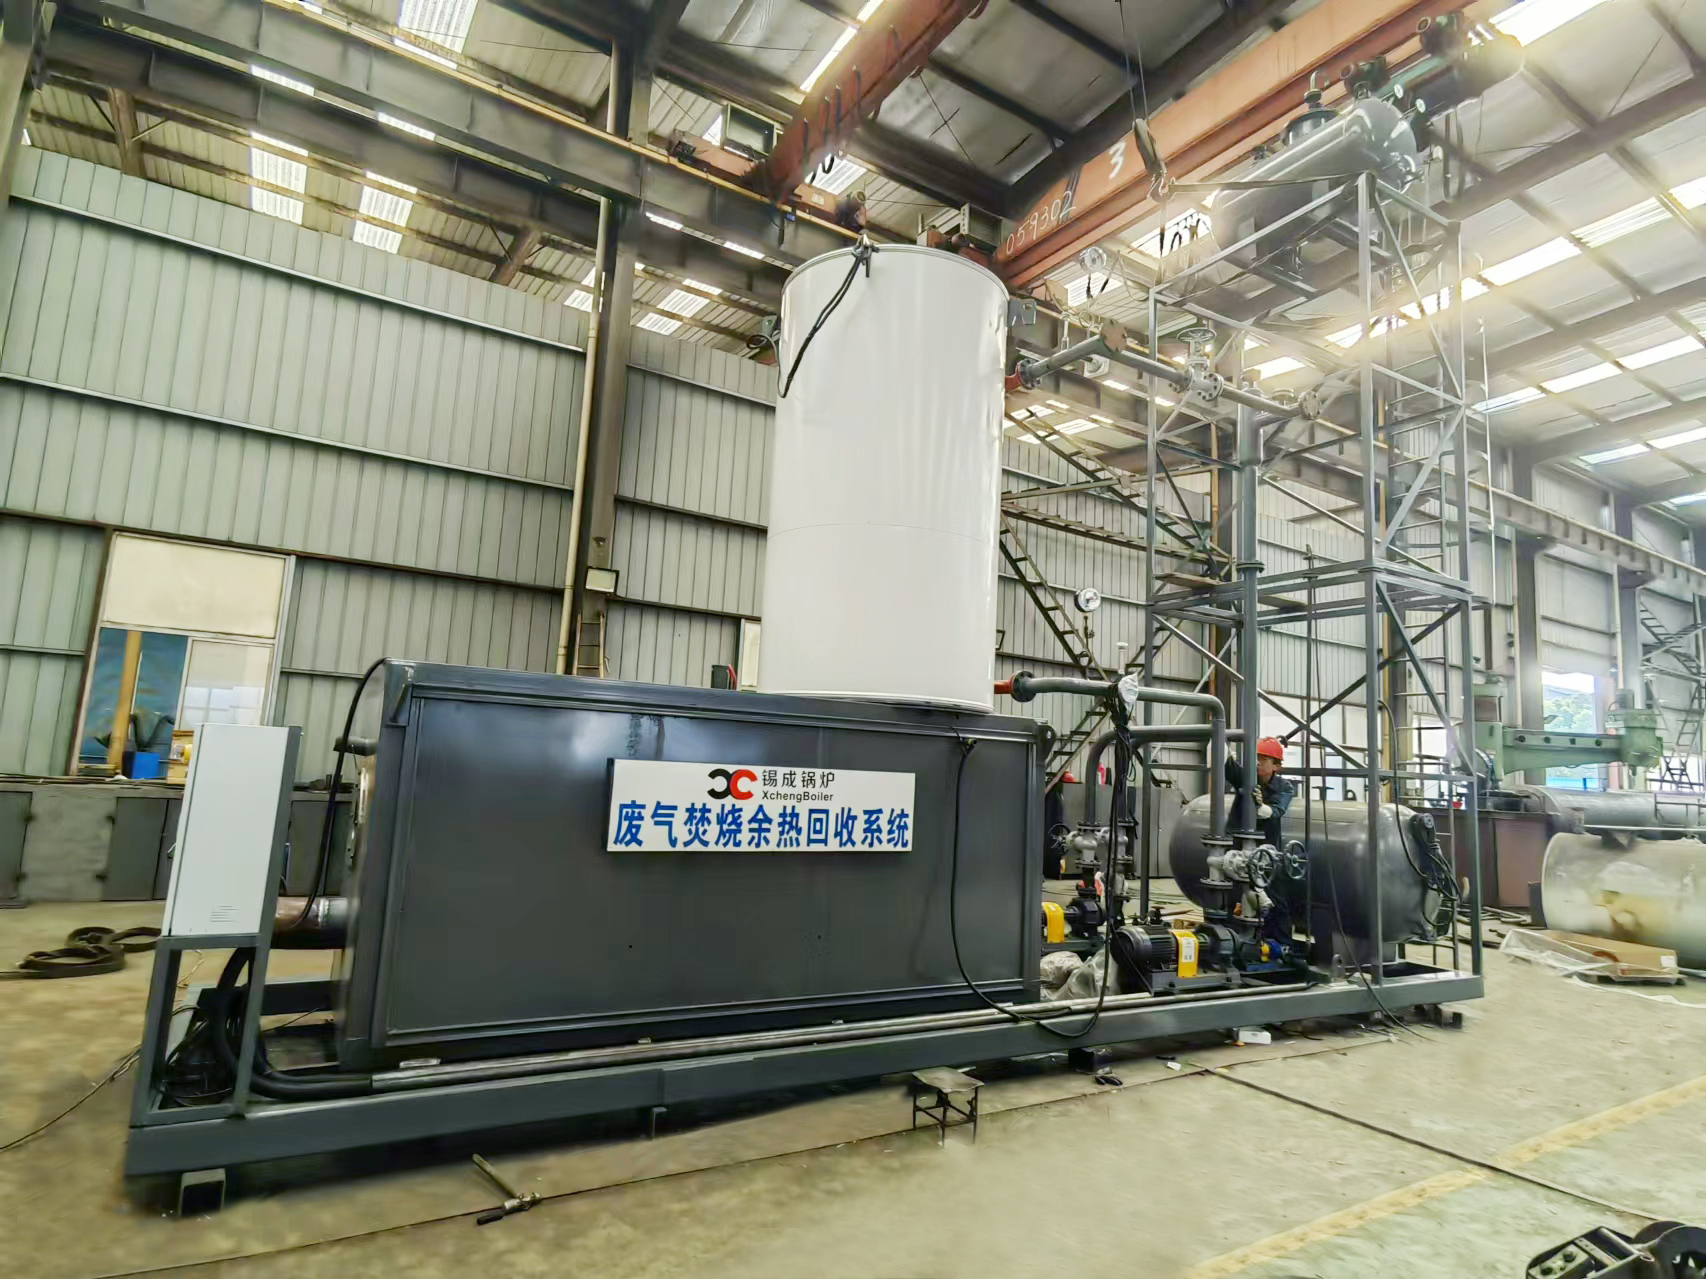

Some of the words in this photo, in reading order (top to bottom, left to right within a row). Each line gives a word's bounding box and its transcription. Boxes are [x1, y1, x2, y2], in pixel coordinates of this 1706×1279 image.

[1108, 140, 1126, 180] 3
[1006, 190, 1077, 255] 059302
[761, 790, 834, 803] XchengBoiler
[762, 769, 835, 789] 锡成锅炉
[613, 800, 910, 849] 废气焚烧余热回收系统
